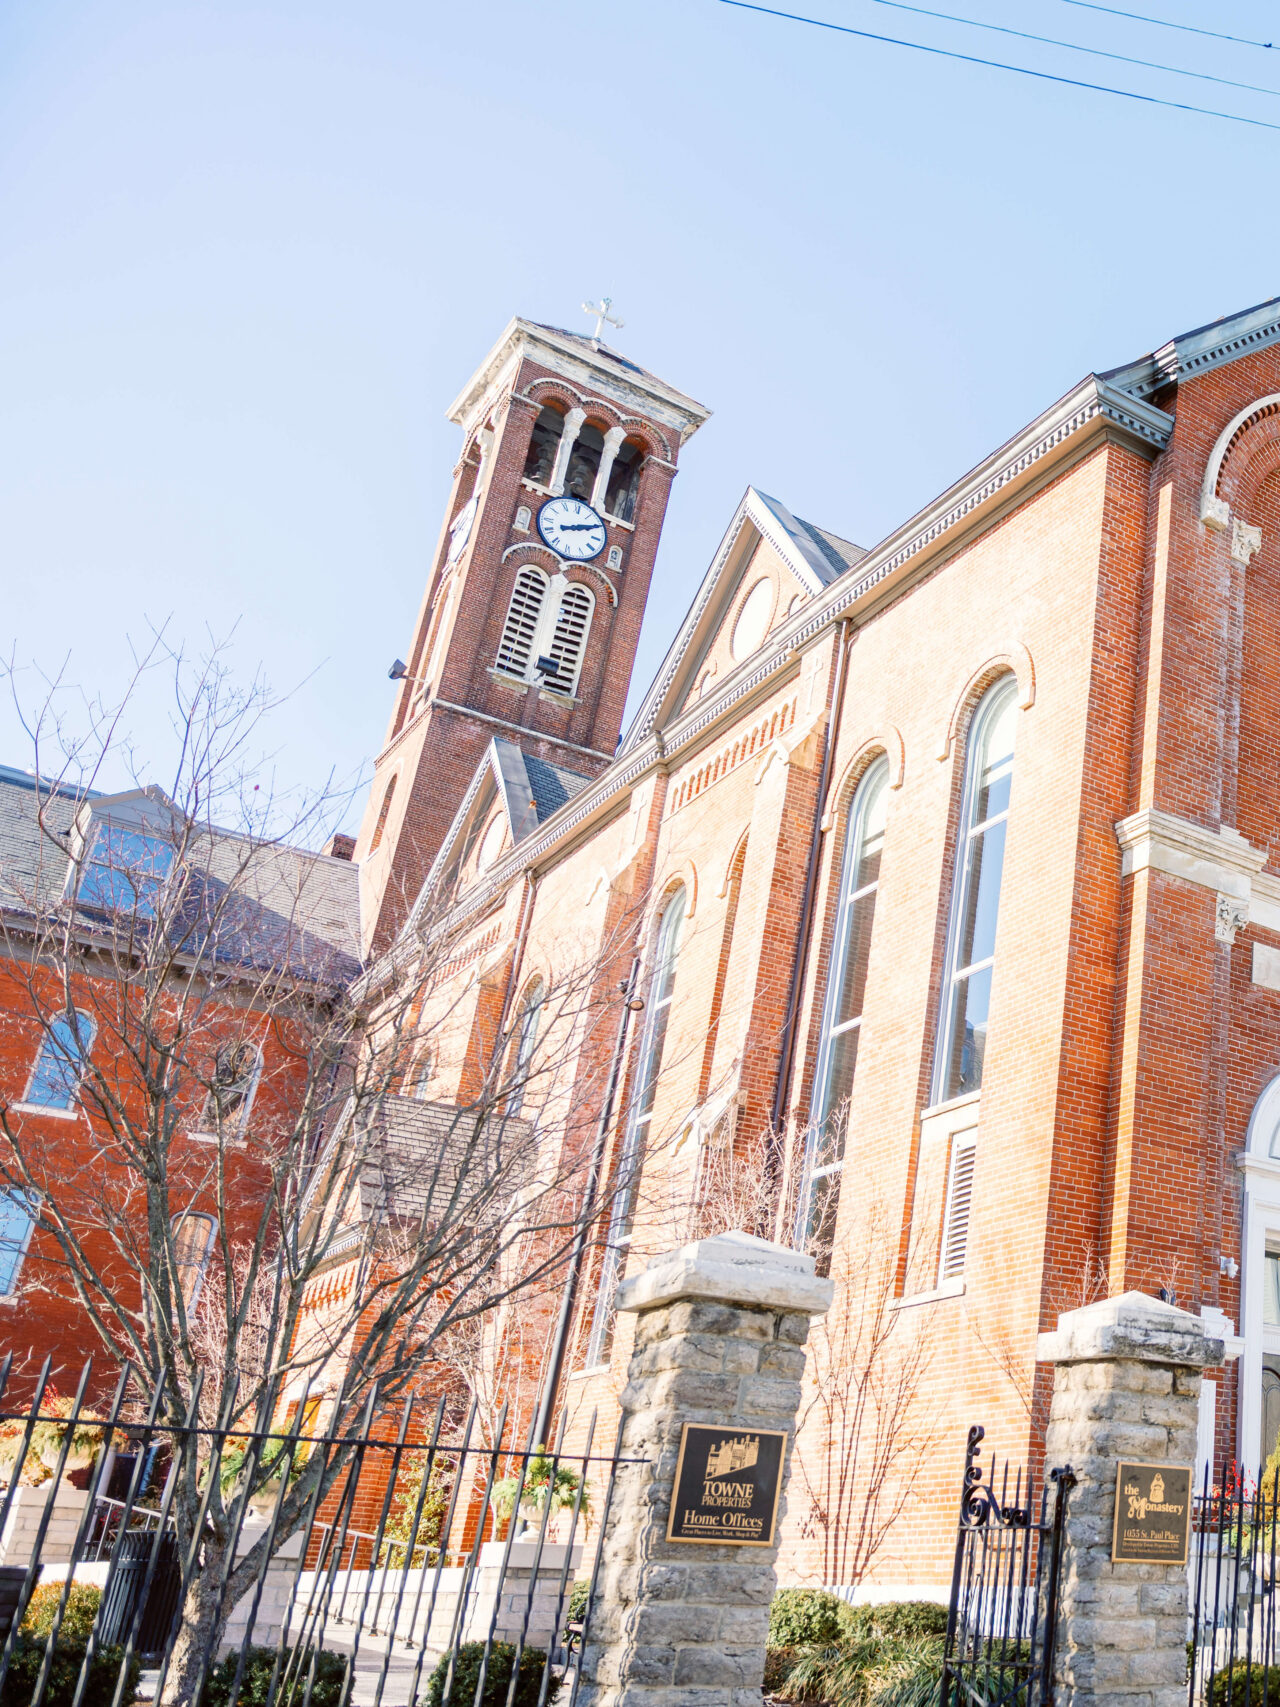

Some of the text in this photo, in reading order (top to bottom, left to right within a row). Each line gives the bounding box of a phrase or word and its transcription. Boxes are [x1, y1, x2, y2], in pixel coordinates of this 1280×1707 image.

[703, 1480, 754, 1499] TOWNE
[1124, 1483, 1140, 1496] the
[701, 1496, 752, 1508] PROPERTIES
[1127, 1495, 1184, 1520] Monastery
[683, 1510, 764, 1528] Home Offices
[1123, 1528, 1140, 1538] 1055
[1150, 1530, 1164, 1539] Paul
[1165, 1531, 1180, 1540] Place
